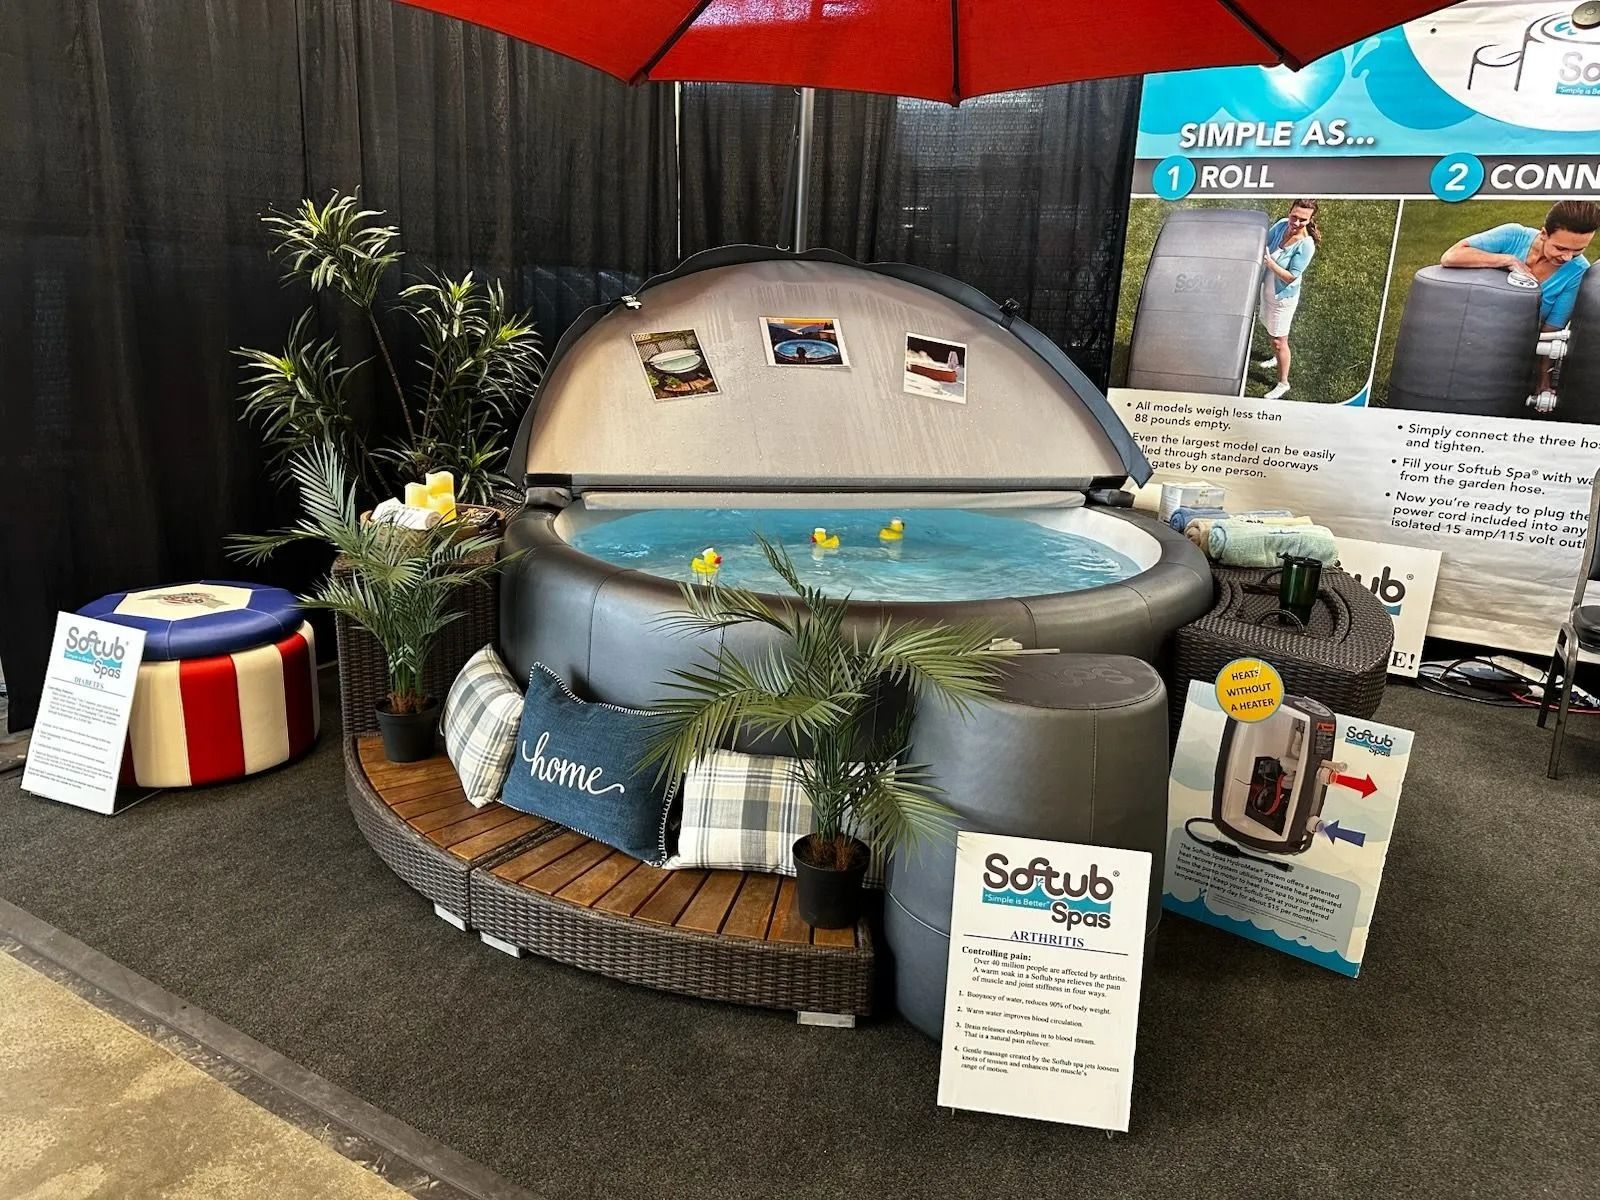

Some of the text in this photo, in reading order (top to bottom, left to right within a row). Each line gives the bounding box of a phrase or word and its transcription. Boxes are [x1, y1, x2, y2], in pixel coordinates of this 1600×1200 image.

[1179, 119, 1375, 148] SIMPLE AS...
[1167, 165, 1275, 191] 1 ROLL
[1445, 162, 1469, 191] 2
[1134, 413, 1230, 430] 88 pounds empty.
[1136, 401, 1282, 421] All models weigh less than
[1132, 432, 1335, 461] Even the largest model can be easily
[1406, 436, 1484, 455] and tighten.
[1408, 423, 1451, 438] Simply
[1455, 428, 1508, 441] connect
[1512, 432, 1536, 443] the
[1539, 434, 1575, 446] three
[1141, 444, 1318, 472] lled through standard doorways
[1151, 459, 1266, 479] gates by one person.
[1402, 456, 1420, 467] Fill
[1424, 461, 1453, 473] your
[1457, 462, 1501, 475] Softub
[1542, 470, 1572, 483] with
[1399, 470, 1545, 494] from the garden hose.
[1396, 490, 1590, 521] Now you're ready to plug the
[1391, 516, 1585, 548] isolated 15 amp/115 volt outl
[1393, 506, 1586, 537] power cord included into any
[66, 626, 125, 660] Softub
[93, 660, 121, 679] Spas
[1226, 683, 1271, 696] WITHOUT
[1240, 698, 1275, 710] HEATER
[1346, 726, 1393, 747] Softub
[522, 731, 625, 795] home
[1368, 745, 1390, 757] Spas
[1015, 897, 1022, 905] is
[1052, 902, 1111, 931] Spas
[1010, 930, 1084, 947] ARTHRITIS
